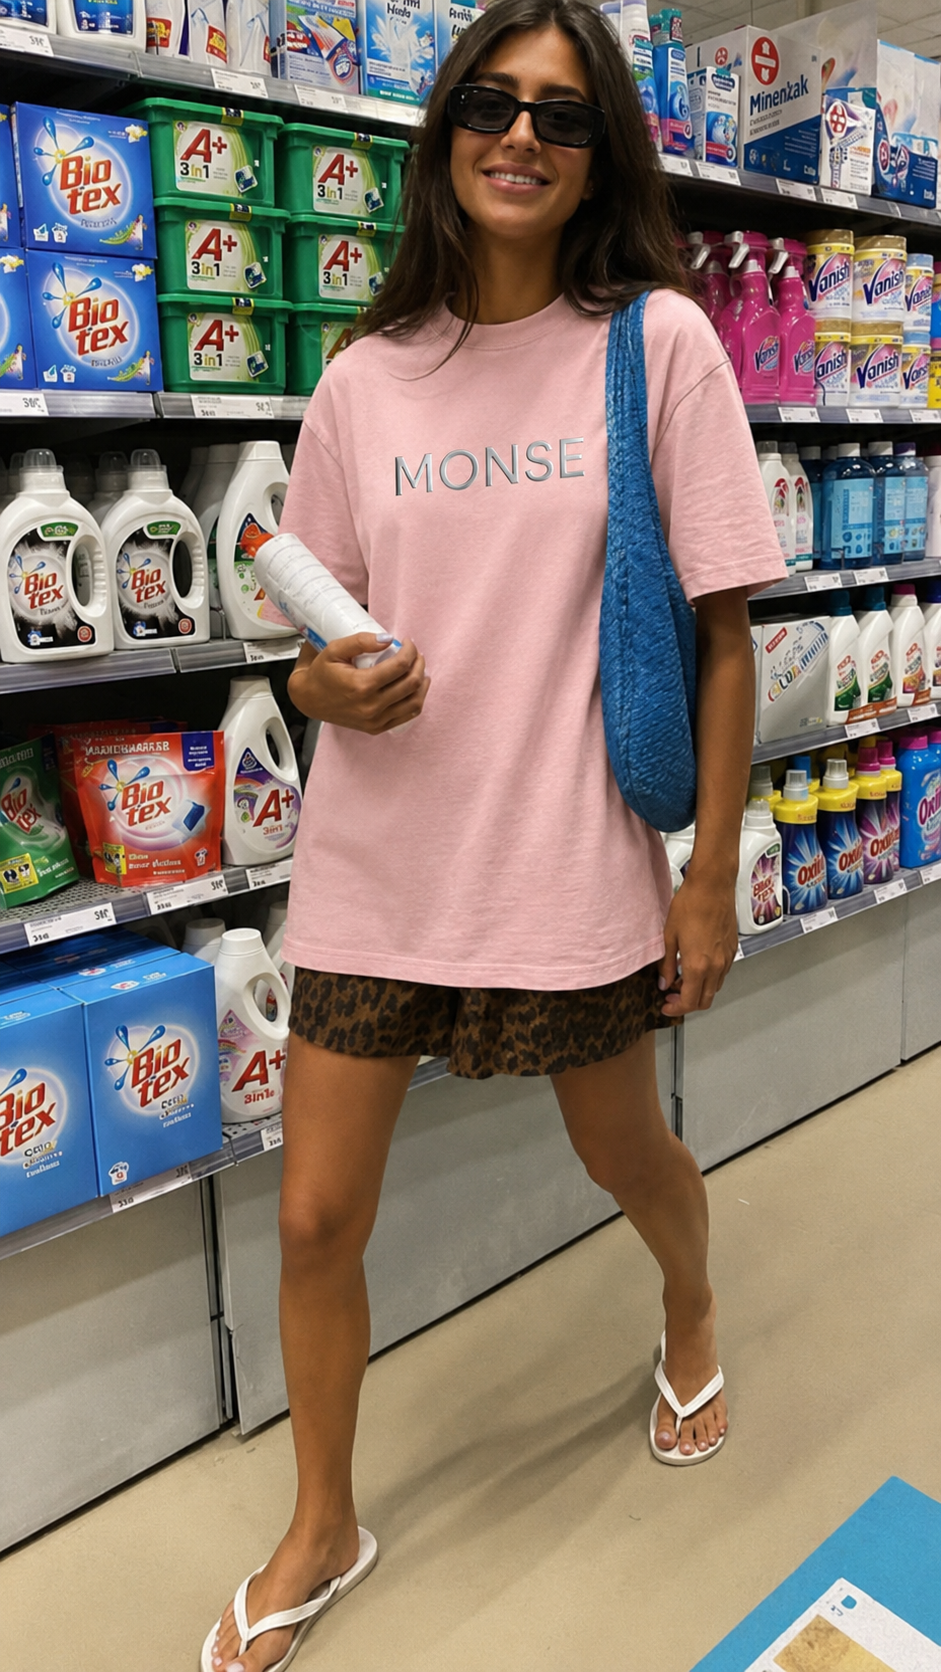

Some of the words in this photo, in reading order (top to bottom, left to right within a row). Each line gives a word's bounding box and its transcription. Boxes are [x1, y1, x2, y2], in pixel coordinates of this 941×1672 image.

[180, 128, 227, 163] A+
[60, 155, 111, 190] Bio
[317, 153, 358, 186] A+
[67, 183, 122, 215] tex
[191, 228, 237, 262] A+
[323, 240, 362, 271] A+
[808, 252, 850, 302] Vanish
[863, 258, 904, 305] Vanish
[68, 297, 119, 332] Bio
[76, 321, 129, 356] tex
[194, 319, 239, 351] A+
[856, 344, 899, 389] Vanish
[395, 437, 585, 496] MONSE
[24, 572, 57, 596] Bio
[131, 568, 161, 590] Bio
[135, 580, 166, 603] tex
[28, 585, 64, 610] tex
[1, 788, 27, 822] Bio
[121, 780, 165, 811] Bio
[126, 796, 172, 828] tex
[252, 788, 295, 828] A+
[131, 1038, 181, 1089] Bio
[231, 1050, 286, 1092] A+
[138, 1057, 190, 1108] tex
[0, 1102, 56, 1157] tex
